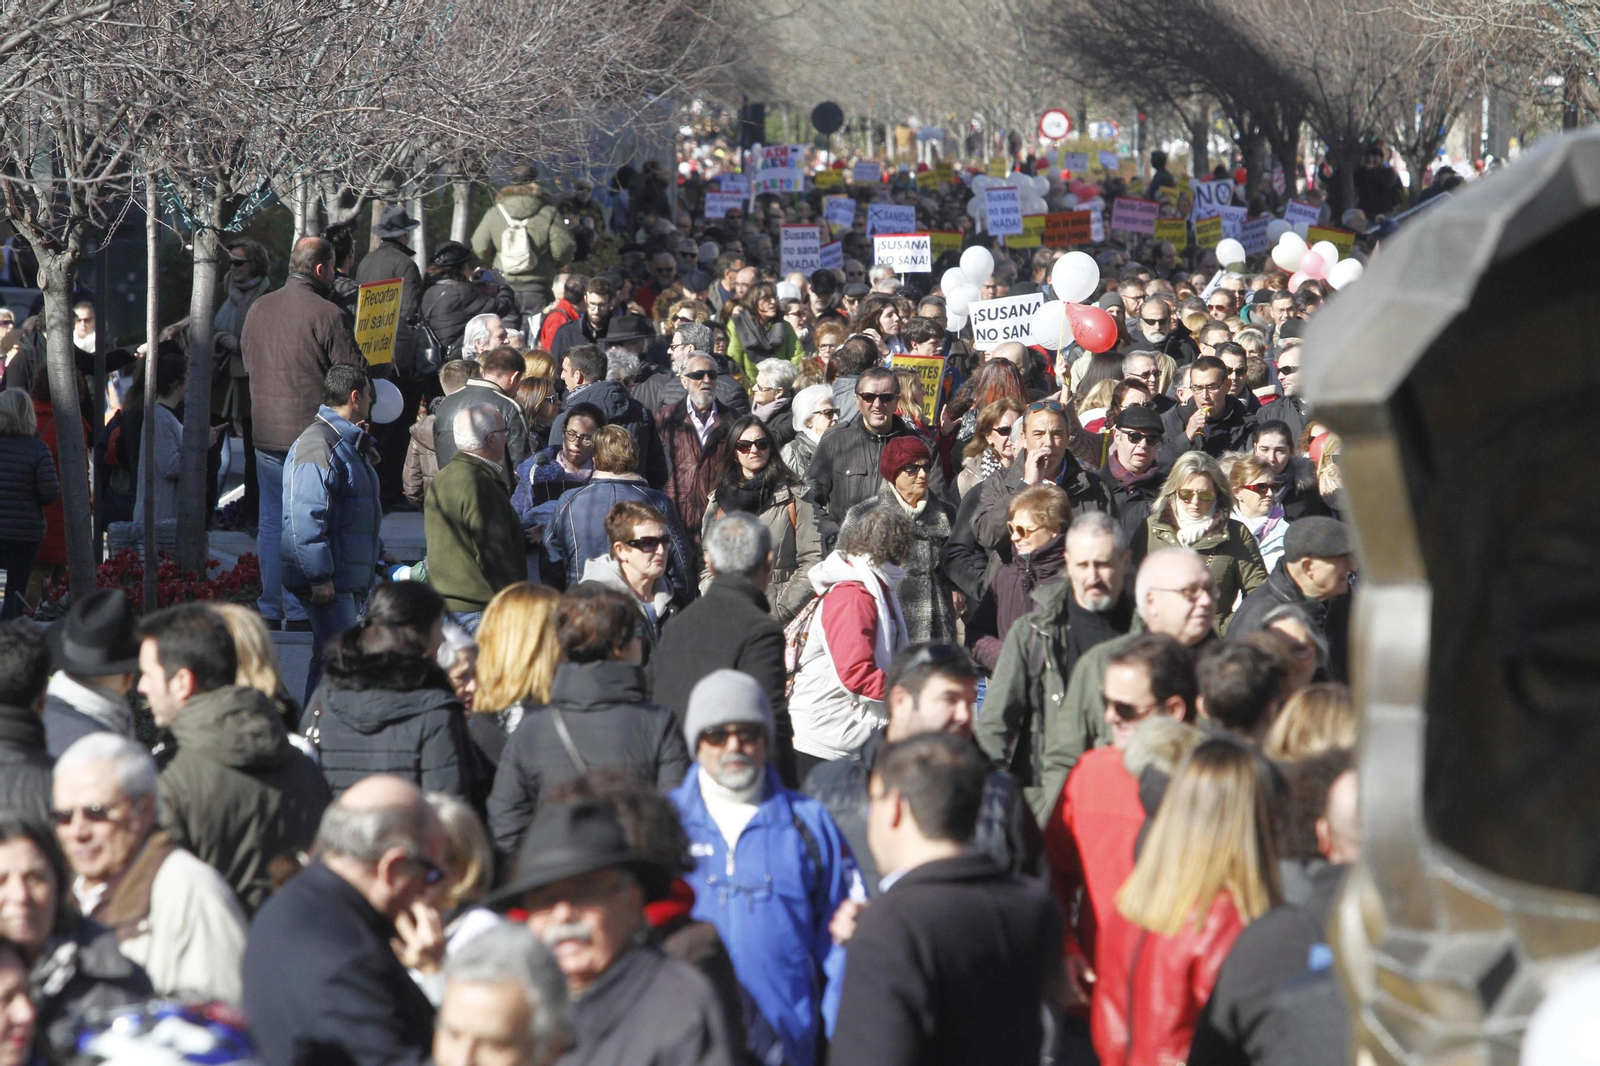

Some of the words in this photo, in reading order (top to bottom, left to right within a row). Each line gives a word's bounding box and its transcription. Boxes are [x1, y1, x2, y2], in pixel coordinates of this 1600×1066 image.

[1196, 182, 1232, 208] NO
[1288, 204, 1317, 219] Susana,
[783, 229, 819, 241] Susana,
[783, 247, 794, 255] no
[797, 246, 819, 255] sana
[877, 240, 928, 252] ¡SUSANA
[877, 256, 894, 265] NO
[898, 256, 928, 265] SANA!
[360, 286, 399, 311] ¡Recortan
[358, 313, 371, 332] mi
[371, 308, 397, 330] salud
[974, 301, 1042, 325] ¡SUSANA
[976, 327, 998, 341] NO
[1003, 323, 1033, 340] SAN
[361, 336, 373, 355] mi
[373, 333, 392, 353] vida!
